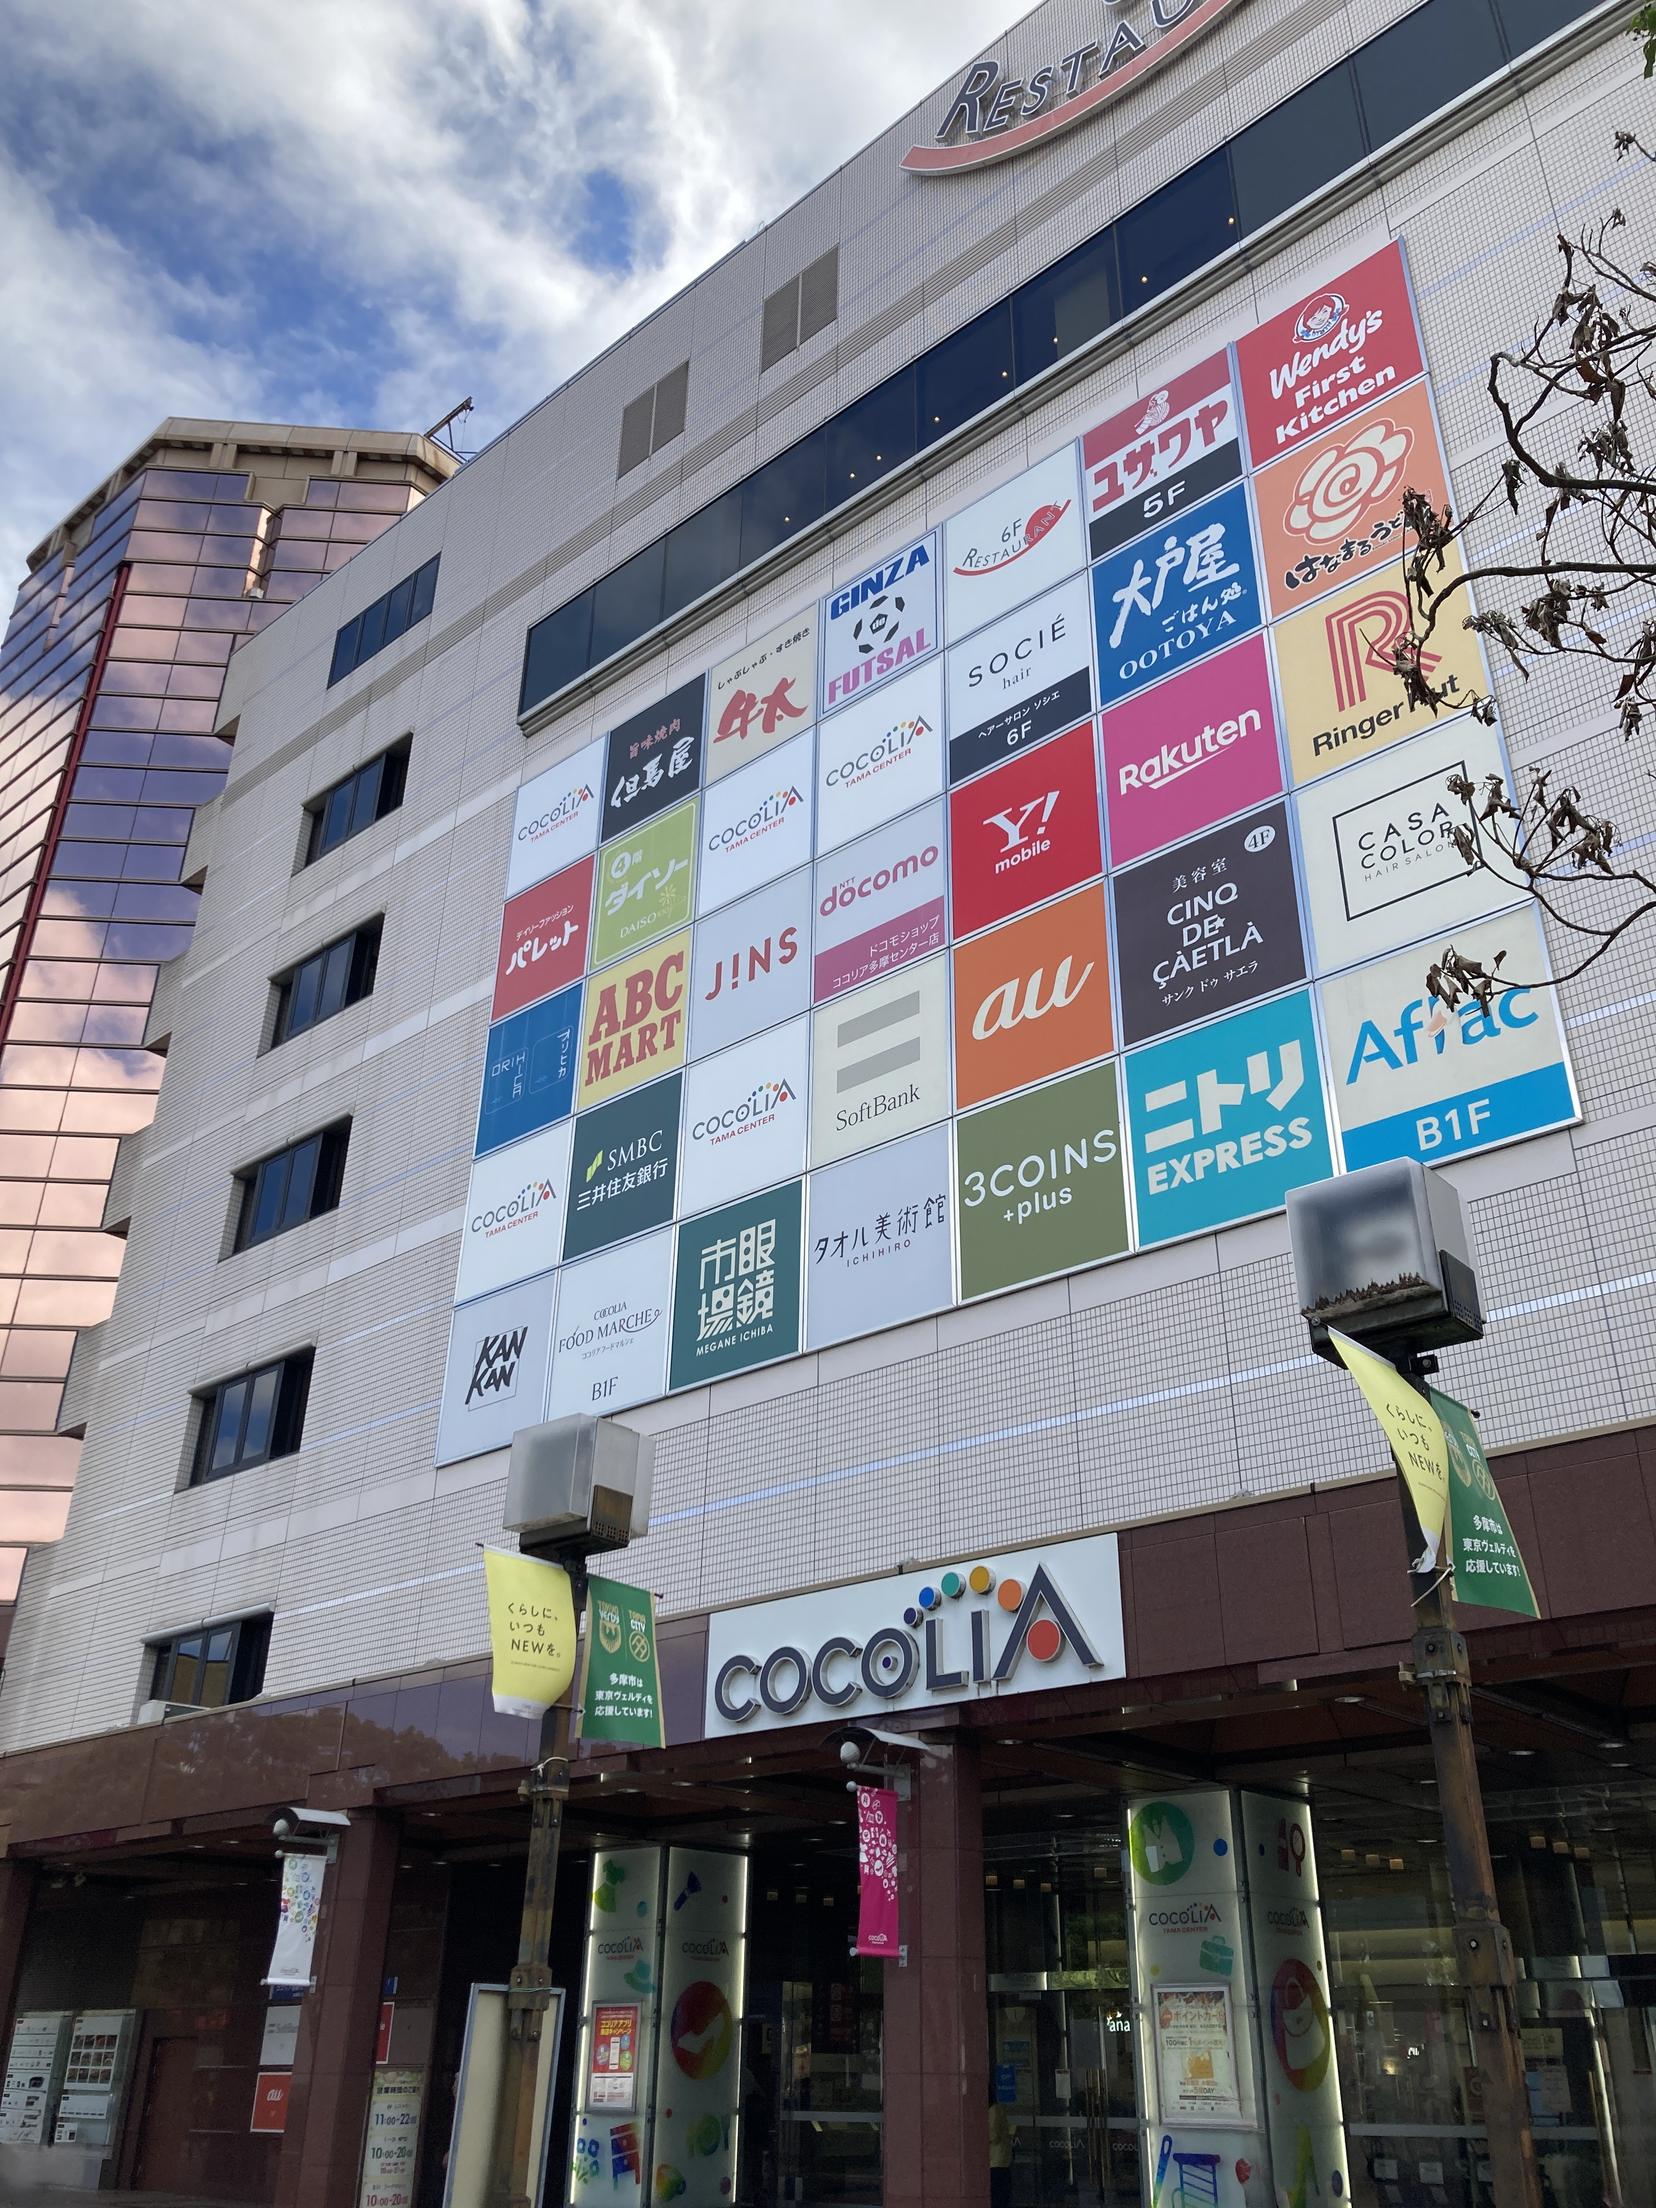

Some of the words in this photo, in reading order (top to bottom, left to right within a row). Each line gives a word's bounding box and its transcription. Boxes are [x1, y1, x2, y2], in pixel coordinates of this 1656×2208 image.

[1269, 308, 1383, 400] Wendy's
[1275, 364, 1396, 445] Kitchen
[1295, 355, 1367, 409] First
[1092, 399, 1229, 512] ユザワヤ
[1143, 480, 1186, 518] 5F
[962, 500, 1062, 568] RESTAURANT
[1001, 518, 1022, 543] 6F
[830, 544, 930, 620] GINZA
[1109, 522, 1240, 649] 大戸屋
[1162, 581, 1243, 633] ごはん処
[872, 617, 887, 632] de
[968, 613, 1067, 688] SOCIÉ
[1119, 610, 1237, 680] OOTOYA
[828, 627, 932, 705] FUTSAL
[1002, 665, 1032, 691] hair
[825, 714, 934, 787] COCOLIA
[1006, 720, 1032, 746] 6F
[1119, 708, 1262, 796] Rakuten
[1312, 700, 1404, 757] Ringer
[611, 736, 695, 808] 但馬屋
[518, 783, 595, 841] COCOLIA
[709, 785, 804, 851] COCOLIA
[983, 790, 1060, 853] Y!
[1247, 828, 1271, 850] 4F
[1358, 802, 1449, 851] CASA
[995, 838, 1051, 875] mobile
[1361, 820, 1454, 870] COLOR
[1364, 861, 1399, 883] HAIR
[605, 858, 689, 916] ダイソー
[819, 845, 939, 917] docomo
[839, 876, 856, 890] NTT
[1172, 857, 1228, 893] 美容室
[620, 912, 657, 939] DAISO
[1167, 882, 1239, 926] CINQ
[1183, 914, 1221, 947] DE
[506, 920, 579, 976] パレット
[832, 931, 940, 989] ココリア多摩センター店
[869, 914, 940, 958] ドコモショップ
[704, 926, 798, 1001] J!NS
[1161, 985, 1194, 1008] サンク
[1223, 960, 1259, 983] サエラ
[588, 950, 684, 1046] ABC
[971, 954, 1095, 1041] au
[585, 1009, 682, 1087] MART
[692, 1078, 797, 1141] COCOLIA
[836, 1082, 921, 1132] SoftBank
[1144, 1039, 1305, 1154] ニトリ
[607, 1129, 663, 1172] SMBC
[1415, 1098, 1492, 1151] B1F
[963, 1129, 1117, 1207] 3COINS
[1147, 1116, 1313, 1196] EXPRESS
[471, 1178, 557, 1233] COCOLIA
[576, 1157, 668, 1211] 三井住友銀行
[814, 1193, 946, 1265] タオル美術館
[846, 1238, 912, 1268] ICHIHIRO
[475, 1325, 528, 1369] KAN
[559, 1327, 594, 1353] FOOD
[696, 1335, 737, 1357] MEGANE
[739, 1323, 774, 1342] ICHIBA
[465, 1360, 516, 1405] KAN
[592, 1376, 619, 1401] B1F
[1397, 1428, 1430, 1452] いつも
[507, 1602, 559, 1621] くらしに、
[509, 1620, 545, 1637] いつも
[714, 1561, 1104, 1723] COCOLIA
[609, 1672, 644, 1688] 多摩市は
[1149, 1902, 1222, 1926] COCOLIA
